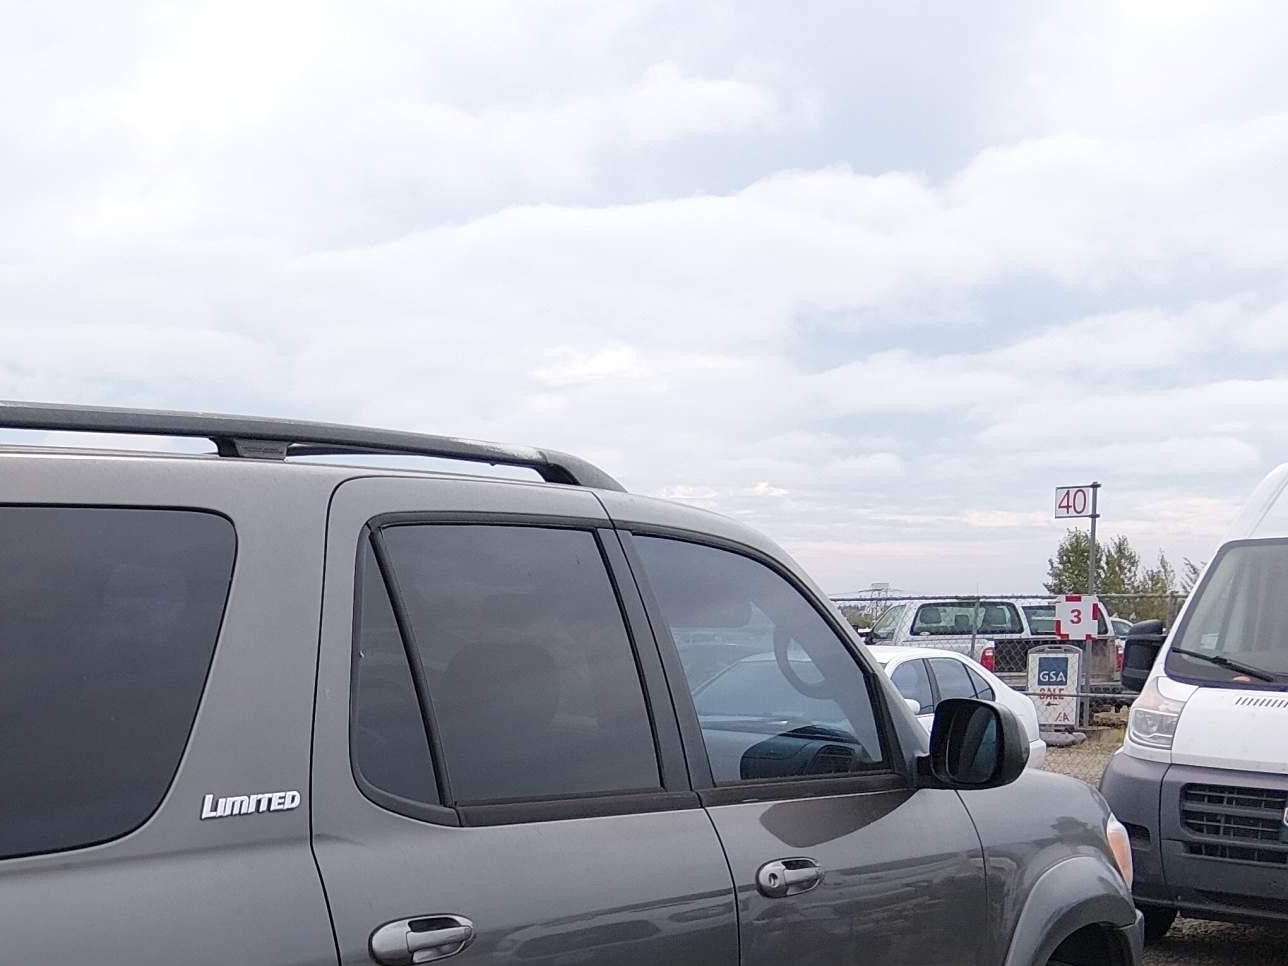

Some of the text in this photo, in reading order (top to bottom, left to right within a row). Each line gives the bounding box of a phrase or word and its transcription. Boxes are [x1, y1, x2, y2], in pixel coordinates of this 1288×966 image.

[1058, 489, 1087, 514] 40
[1070, 609, 1082, 624] 3
[1039, 671, 1066, 682] GSA
